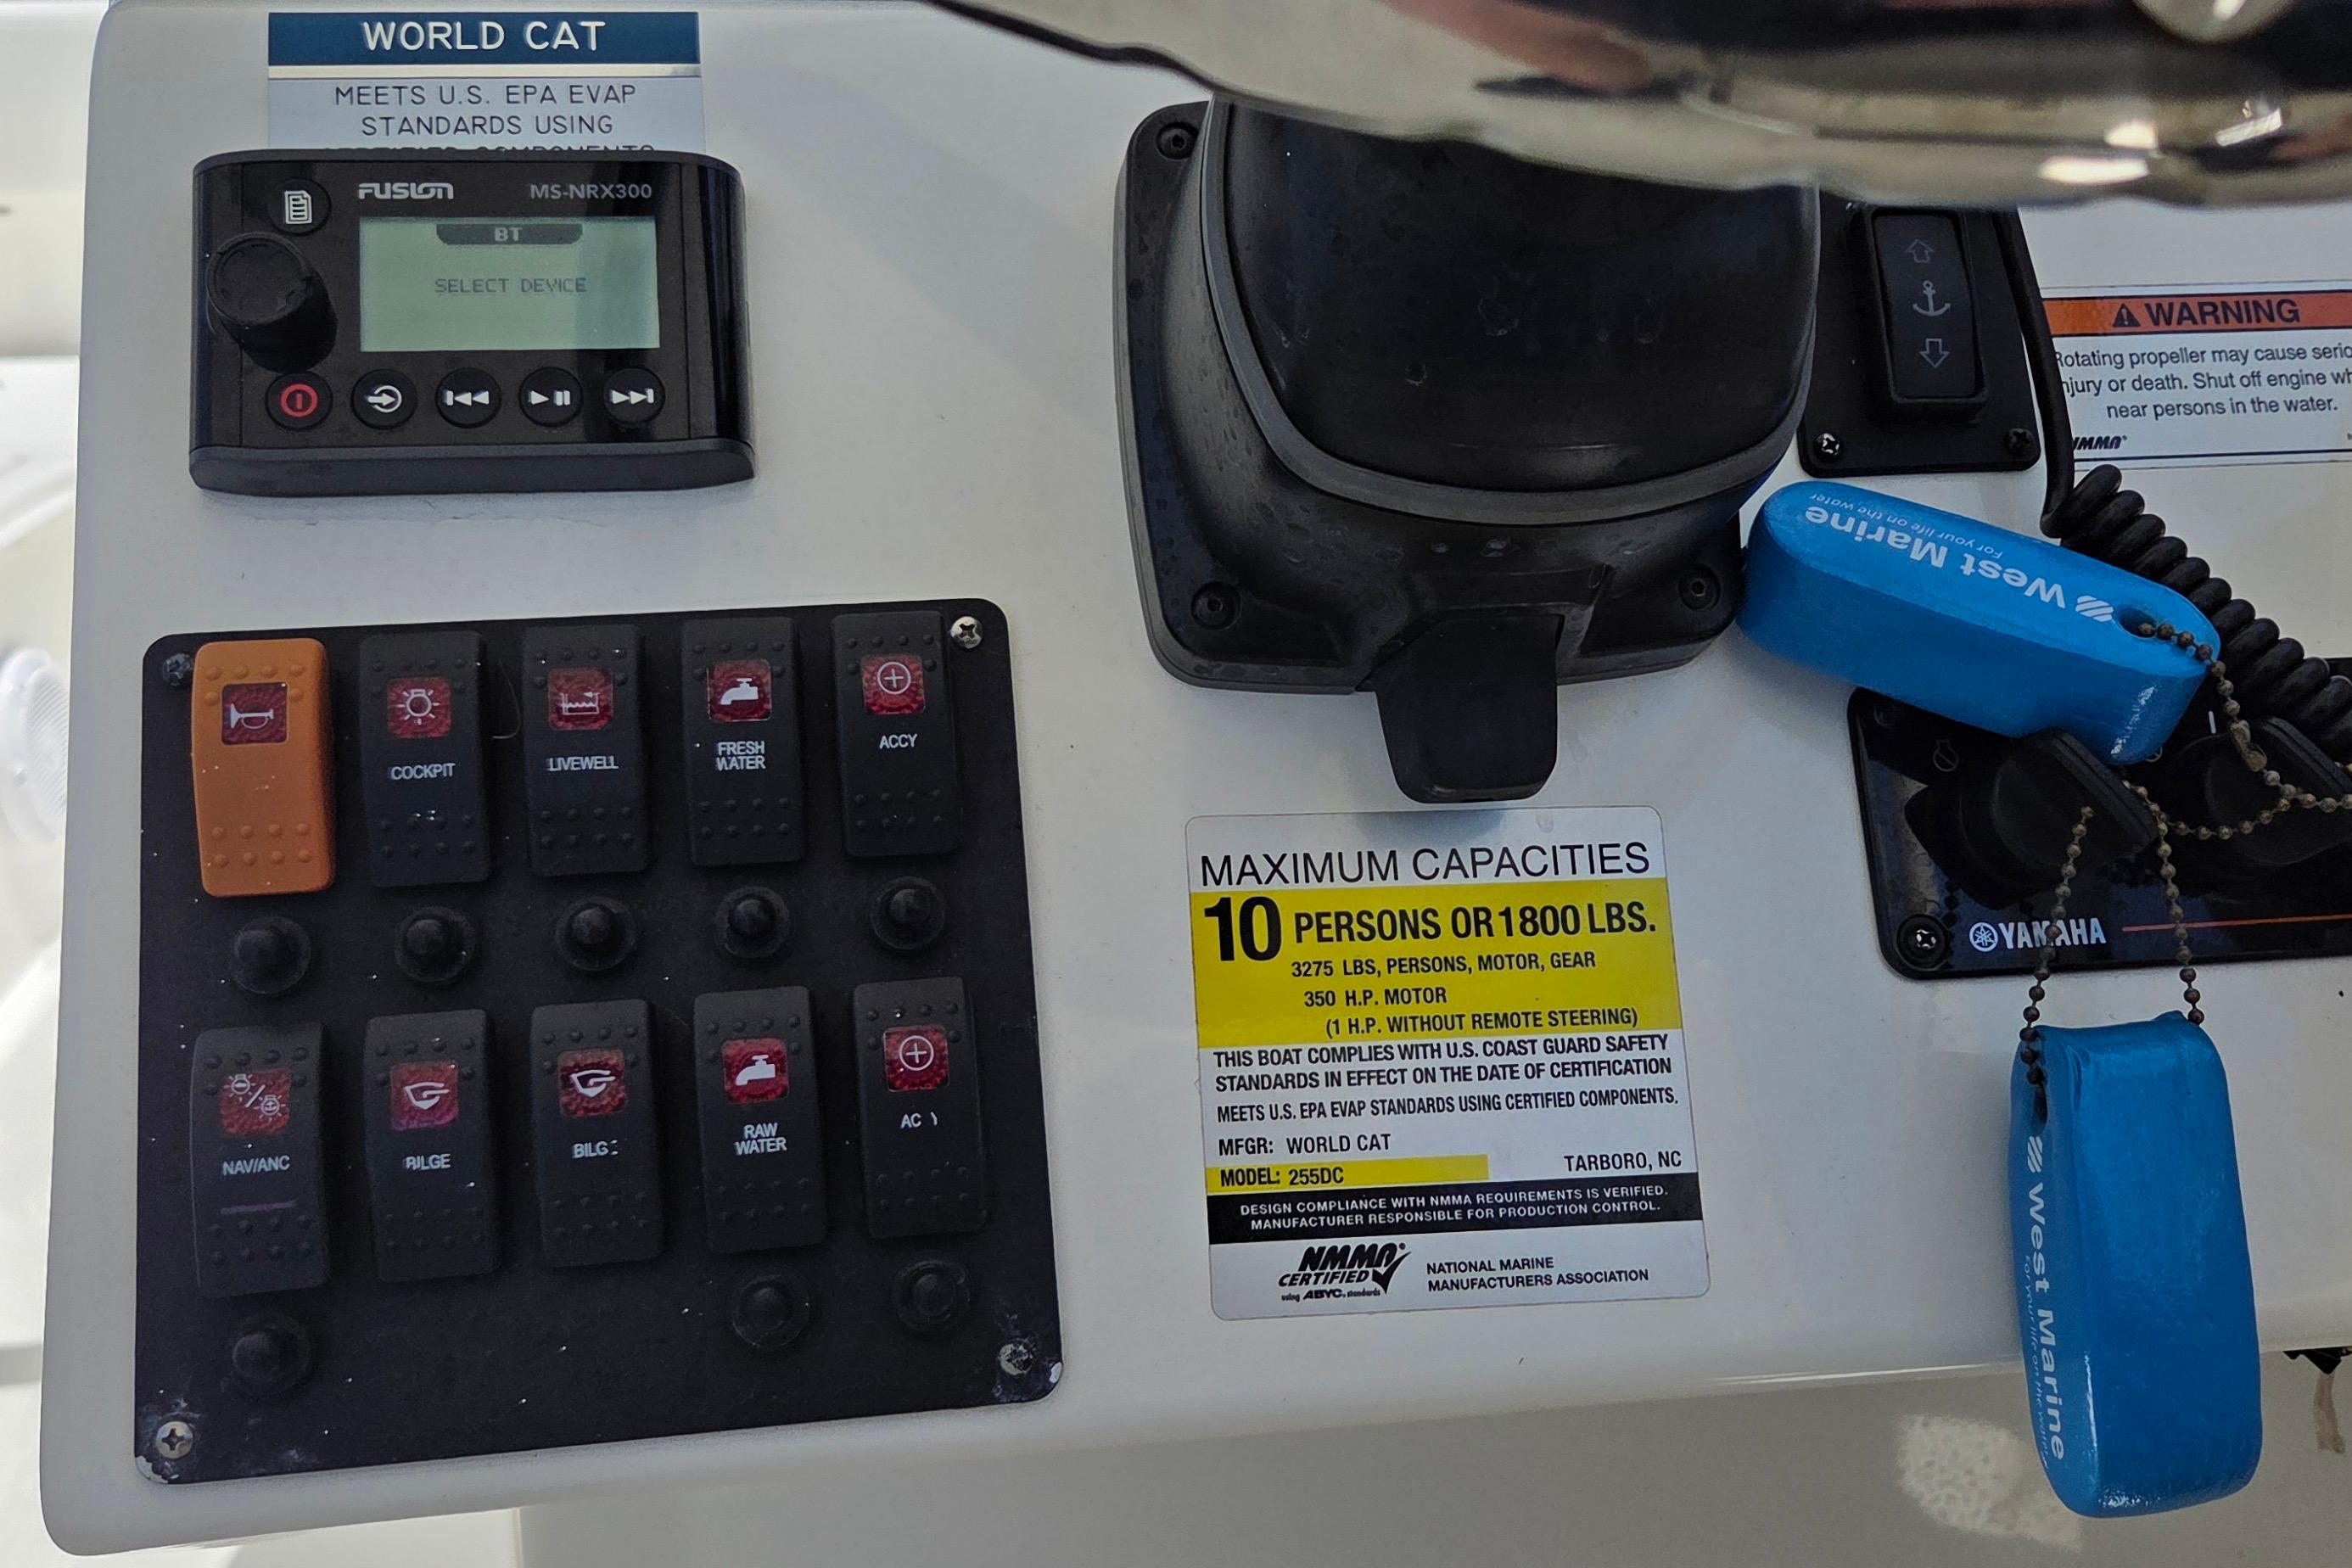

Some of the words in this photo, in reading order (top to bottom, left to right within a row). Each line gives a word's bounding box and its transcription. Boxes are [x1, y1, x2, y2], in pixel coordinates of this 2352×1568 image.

[362, 21, 505, 51] WORLD
[526, 20, 606, 51] CAT
[335, 86, 425, 106] MEETS
[440, 85, 490, 105] U.S.
[506, 85, 557, 104] EPA
[569, 84, 636, 104] EVAP
[362, 115, 523, 136] STANDARDS
[535, 115, 613, 135] USING
[359, 182, 454, 200] FUSION
[530, 183, 652, 200] MS-NRX300
[495, 227, 523, 242] BT
[434, 277, 509, 294] SELECT
[521, 277, 588, 294] DEVICE
[2144, 299, 2300, 327] WARNING
[2129, 348, 2206, 369] propeller
[2212, 348, 2249, 366] may
[2254, 346, 2308, 362] cause
[2062, 377, 2103, 398] njury
[2108, 378, 2126, 393] or
[2131, 372, 2188, 393] death.
[2193, 371, 2236, 390] Shut
[2240, 369, 2263, 389] off
[2267, 368, 2327, 390] engine
[2107, 402, 2148, 420] near
[2153, 400, 2226, 421] persons
[2230, 397, 2247, 414] in
[2251, 396, 2280, 413] the
[2283, 395, 2338, 412] water.
[1809, 492, 1855, 511] water
[1856, 505, 1882, 520] the
[1887, 514, 1908, 528] on
[1805, 505, 1948, 568] Marine
[1912, 523, 1936, 537] life
[1938, 531, 1976, 549] your
[1977, 544, 2002, 559] For
[1960, 552, 2067, 609] West
[718, 740, 765, 756] FRESH
[879, 733, 918, 750] ACCY
[390, 762, 456, 781] COCKPIT
[547, 755, 619, 772] LIVEWELL
[716, 755, 766, 771] WATER
[1201, 849, 1399, 887] MAXIMUM
[1412, 842, 1649, 880] CAPACITIES
[1204, 895, 1282, 961] 10
[1295, 908, 1442, 944] PERSONS
[1452, 905, 1494, 938] OR
[1498, 904, 1580, 937] 1800
[1587, 901, 1656, 933] LBS.
[1291, 961, 1334, 977] 3275
[1343, 959, 1381, 977] LBS,
[1386, 955, 1472, 975] PERSONS,
[1477, 953, 1545, 972] MOTOR,
[1550, 951, 1596, 969] GEAR
[1304, 990, 1336, 1007] 350
[1345, 988, 1379, 1006] H.P.
[1385, 987, 1448, 1005] MOTOR
[1325, 1018, 1340, 1039] (1
[1348, 1017, 1381, 1034] H.P.
[1386, 1014, 1465, 1033] WITHOUT
[1472, 1011, 1543, 1029] REMOTE
[1548, 1007, 1638, 1028] STEERING)
[1213, 1050, 1254, 1067] THIS
[1257, 1048, 1302, 1067] BOAT
[1308, 1044, 1395, 1064] COMPLIES
[1397, 1043, 1442, 1061] WITH
[1447, 1041, 1479, 1059] U.S.
[1482, 1039, 1537, 1057] COAST
[1543, 1037, 1601, 1055] GUARD
[1605, 1033, 1668, 1052] SAFETY
[1215, 1072, 1320, 1092] STANDARDS
[1324, 1071, 1342, 1088] IN
[1347, 1068, 1408, 1086] EFFECT
[1413, 1067, 1436, 1084] ON
[1440, 1066, 1473, 1082] THE
[1477, 1063, 1520, 1082] DATE
[1524, 1062, 1546, 1079] OF
[1549, 1057, 1672, 1079] CERTIFICATION
[1217, 1105, 1265, 1123] MEETS
[1269, 1102, 1296, 1121] U.S.
[1300, 1101, 1327, 1119] EPA
[1330, 1100, 1367, 1118] EVAP
[1370, 1095, 1455, 1117] STANDARDS
[1459, 1095, 1502, 1112] USING
[1505, 1091, 1576, 1111] CERTIFIED
[1579, 1087, 1678, 1106] COMPONENTS.
[744, 1122, 778, 1140] RAW
[733, 1136, 788, 1156] WATER
[1218, 1137, 1274, 1156] MFGR:
[1286, 1135, 1351, 1154] WORLD
[1357, 1134, 1392, 1151] CAT
[222, 1155, 290, 1177] NAV/ANC
[405, 1154, 451, 1171] BILGE
[1564, 1151, 1653, 1172] TARBORO,
[1658, 1151, 1683, 1168] NC
[1220, 1168, 1281, 1187] MODEL:
[1289, 1167, 1344, 1185] 255DC
[1240, 1201, 1292, 1216] DESIGN
[1296, 1197, 1387, 1213] COMPLIANCE
[1391, 1196, 1426, 1209] WITH
[1430, 1194, 1472, 1207] NMMA
[1476, 1189, 1583, 1205] REQUIREMENTS
[1587, 1188, 1599, 1199] IS
[1603, 1185, 1669, 1198] VERIFIED.
[1251, 1213, 1364, 1230] MANUFACTURER
[1369, 1209, 1464, 1225] RESPONSIBLE
[1467, 1208, 1495, 1220] FOR
[1498, 1203, 1588, 1219] PRODUCTION
[1592, 1201, 1661, 1214] CONTROL.
[2029, 1181, 2050, 1293] West
[1426, 1260, 1496, 1275] NATIONAL
[1499, 1257, 1554, 1272] MARINE
[1278, 1269, 1370, 1288] CERTIFIED
[1429, 1274, 1553, 1292] MANUFACTURERS
[1556, 1269, 1649, 1286] ASSOCIATION
[2037, 1308, 2064, 1460] Marine
